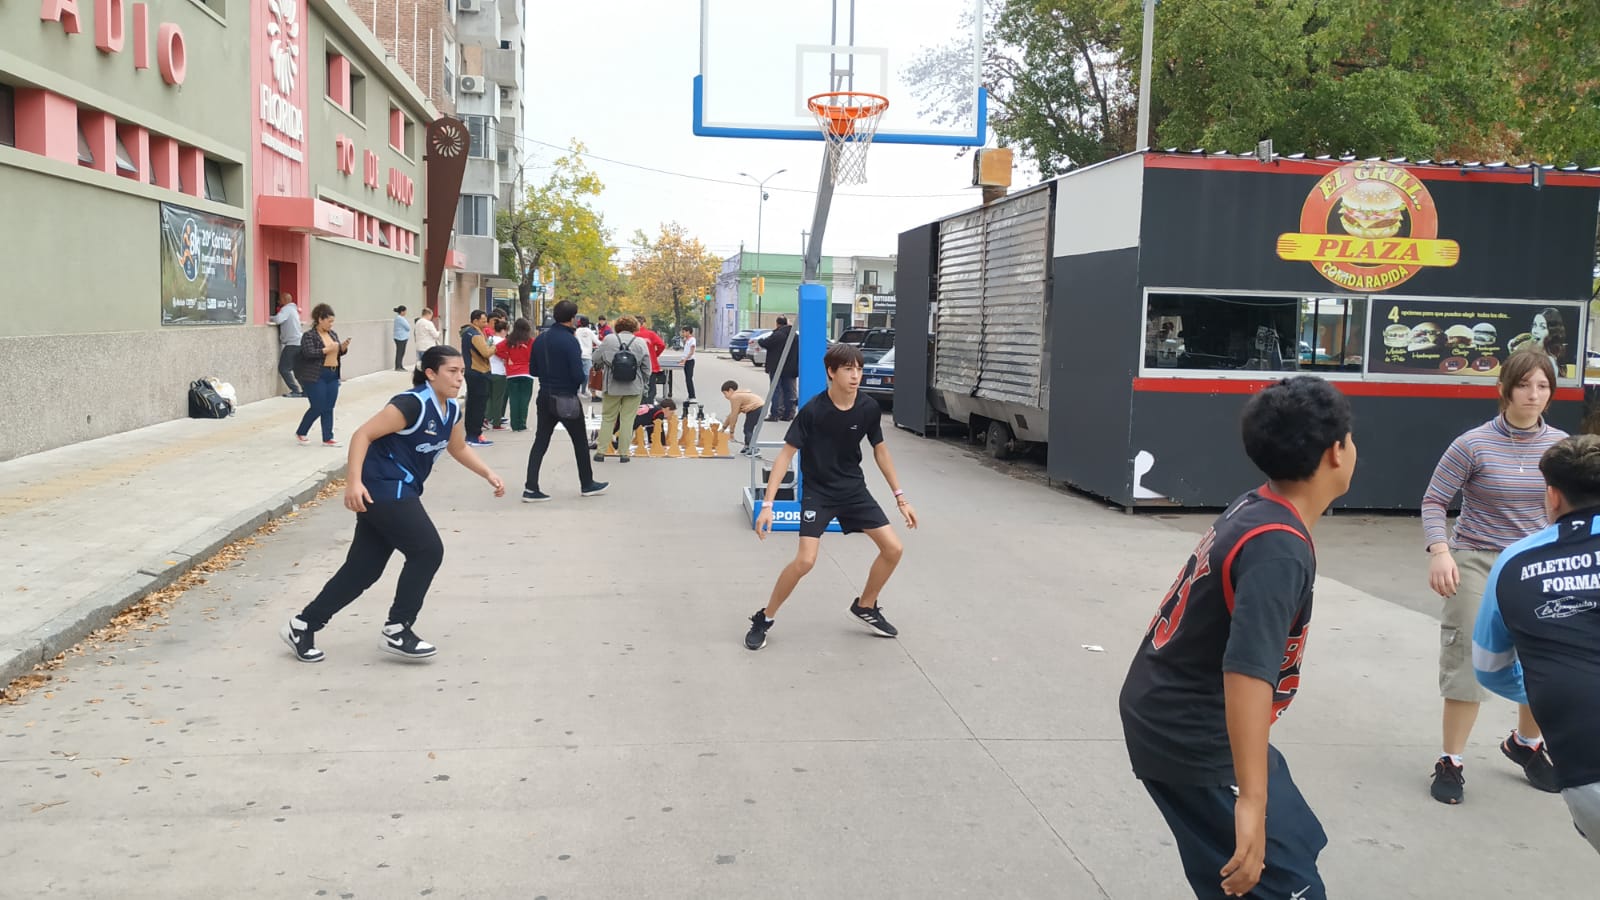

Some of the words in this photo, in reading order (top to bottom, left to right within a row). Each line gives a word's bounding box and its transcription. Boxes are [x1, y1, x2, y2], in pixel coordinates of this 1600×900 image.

[260, 83, 304, 142] FLORIDA
[336, 134, 355, 175] 10
[363, 149, 380, 189] DE
[387, 167, 414, 206] JULIO
[1319, 171, 1347, 200] EL
[211, 231, 232, 251] Corrida
[1314, 238, 1420, 261] PLAZA
[1321, 262, 1364, 288] COMIDA
[1365, 265, 1408, 288] RAPIDA
[1388, 305, 1400, 323] 4
[1520, 553, 1592, 581] ATLETICO
